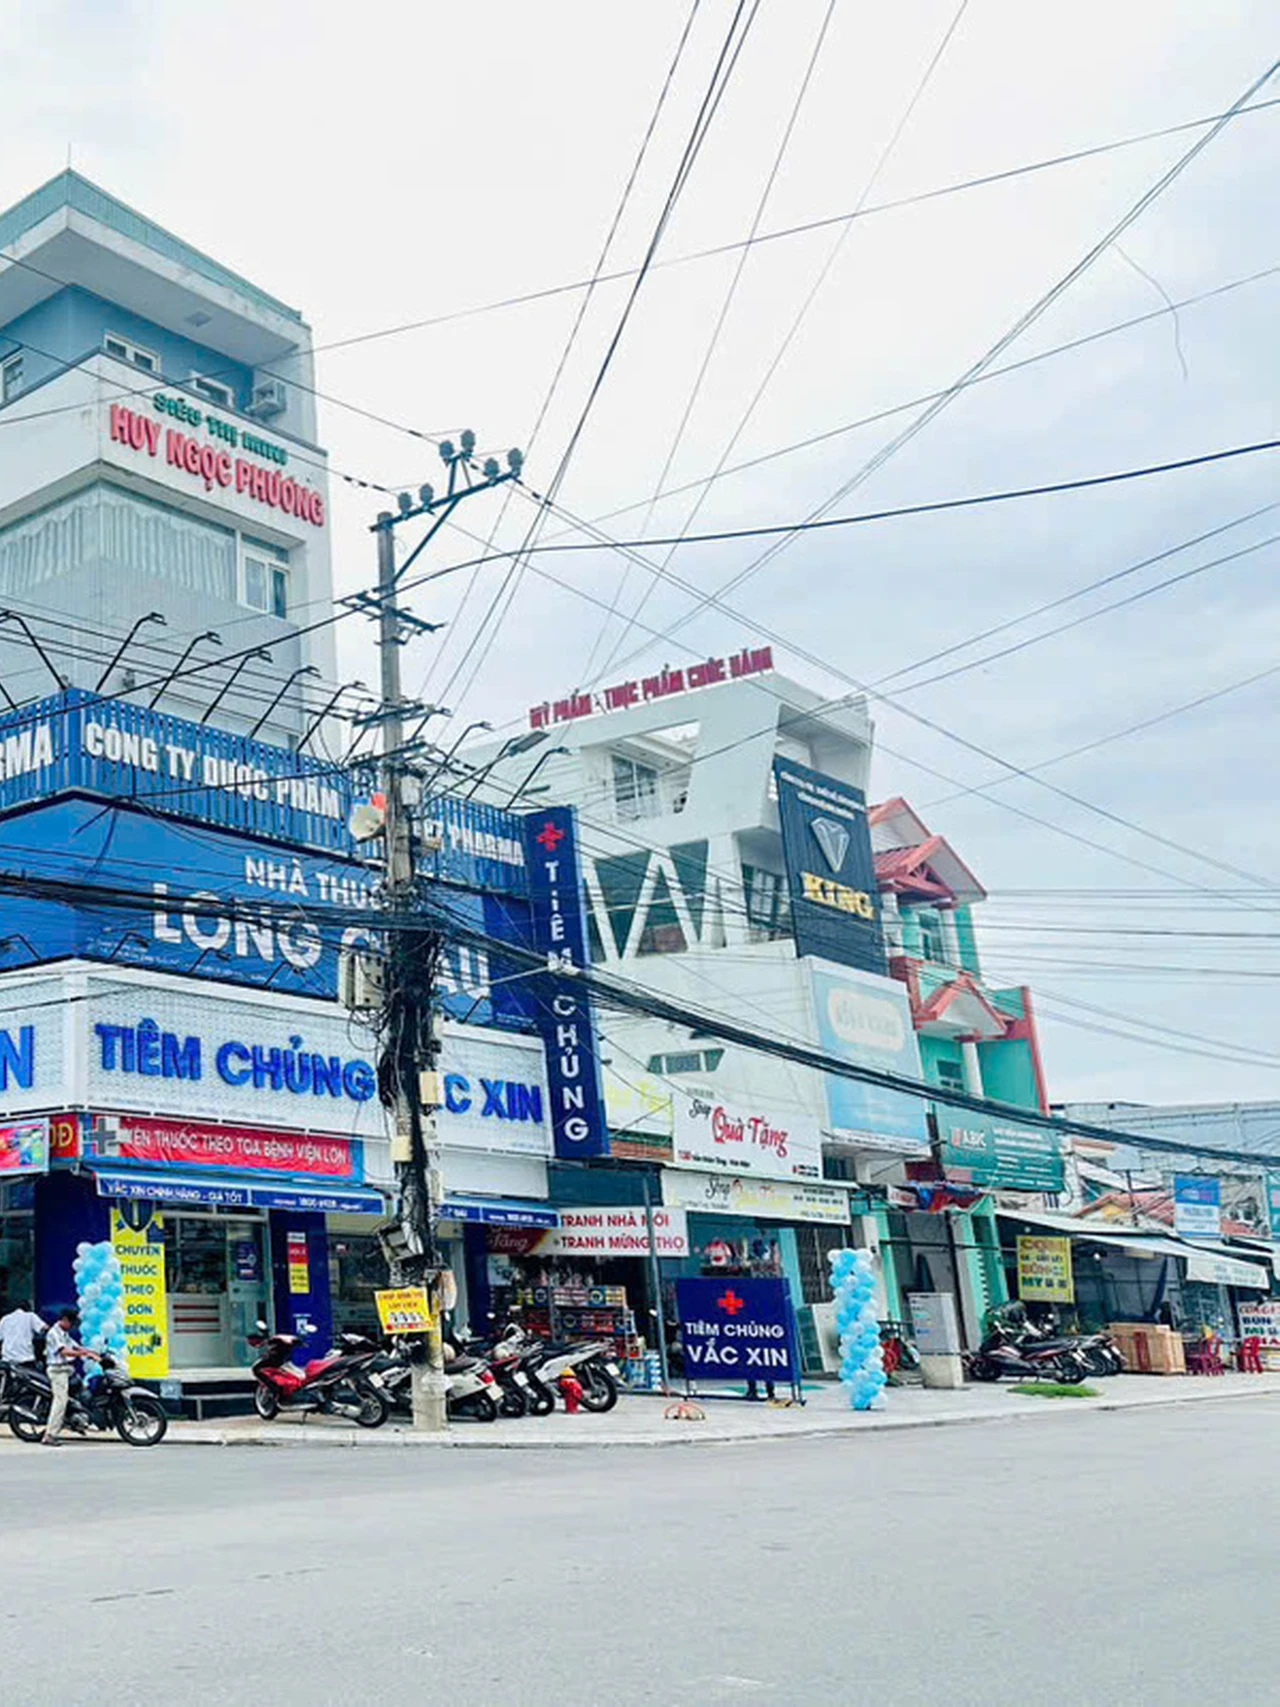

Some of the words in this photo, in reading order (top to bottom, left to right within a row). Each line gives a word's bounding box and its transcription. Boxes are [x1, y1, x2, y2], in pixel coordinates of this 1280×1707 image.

[110, 403, 162, 457] HUY
[166, 428, 232, 491] NGỌC
[235, 458, 325, 526] PHƯƠNG
[85, 718, 158, 772] CÔNG
[165, 745, 197, 781] TY
[245, 855, 309, 897] NHÀ
[153, 882, 322, 968] LONG
[94, 1017, 202, 1080] TIÊM
[215, 1034, 377, 1102] CHỦNG
[479, 1078, 543, 1124] XIN
[155, 1124, 198, 1151] THUỐC
[201, 1134, 233, 1152] THEO
[237, 1137, 261, 1154] TOA
[712, 1106, 744, 1144] Quà
[747, 1115, 789, 1158] Tặng
[560, 1214, 603, 1227] TRANH
[608, 1211, 636, 1227] NHÀ
[561, 1236, 605, 1249] TRANH
[123, 1284, 155, 1295] THEO
[685, 1319, 719, 1336] TIÊM
[723, 1320, 784, 1338] CHỦNG
[686, 1337, 738, 1365] VẮC
[746, 1347, 789, 1367] XIN
